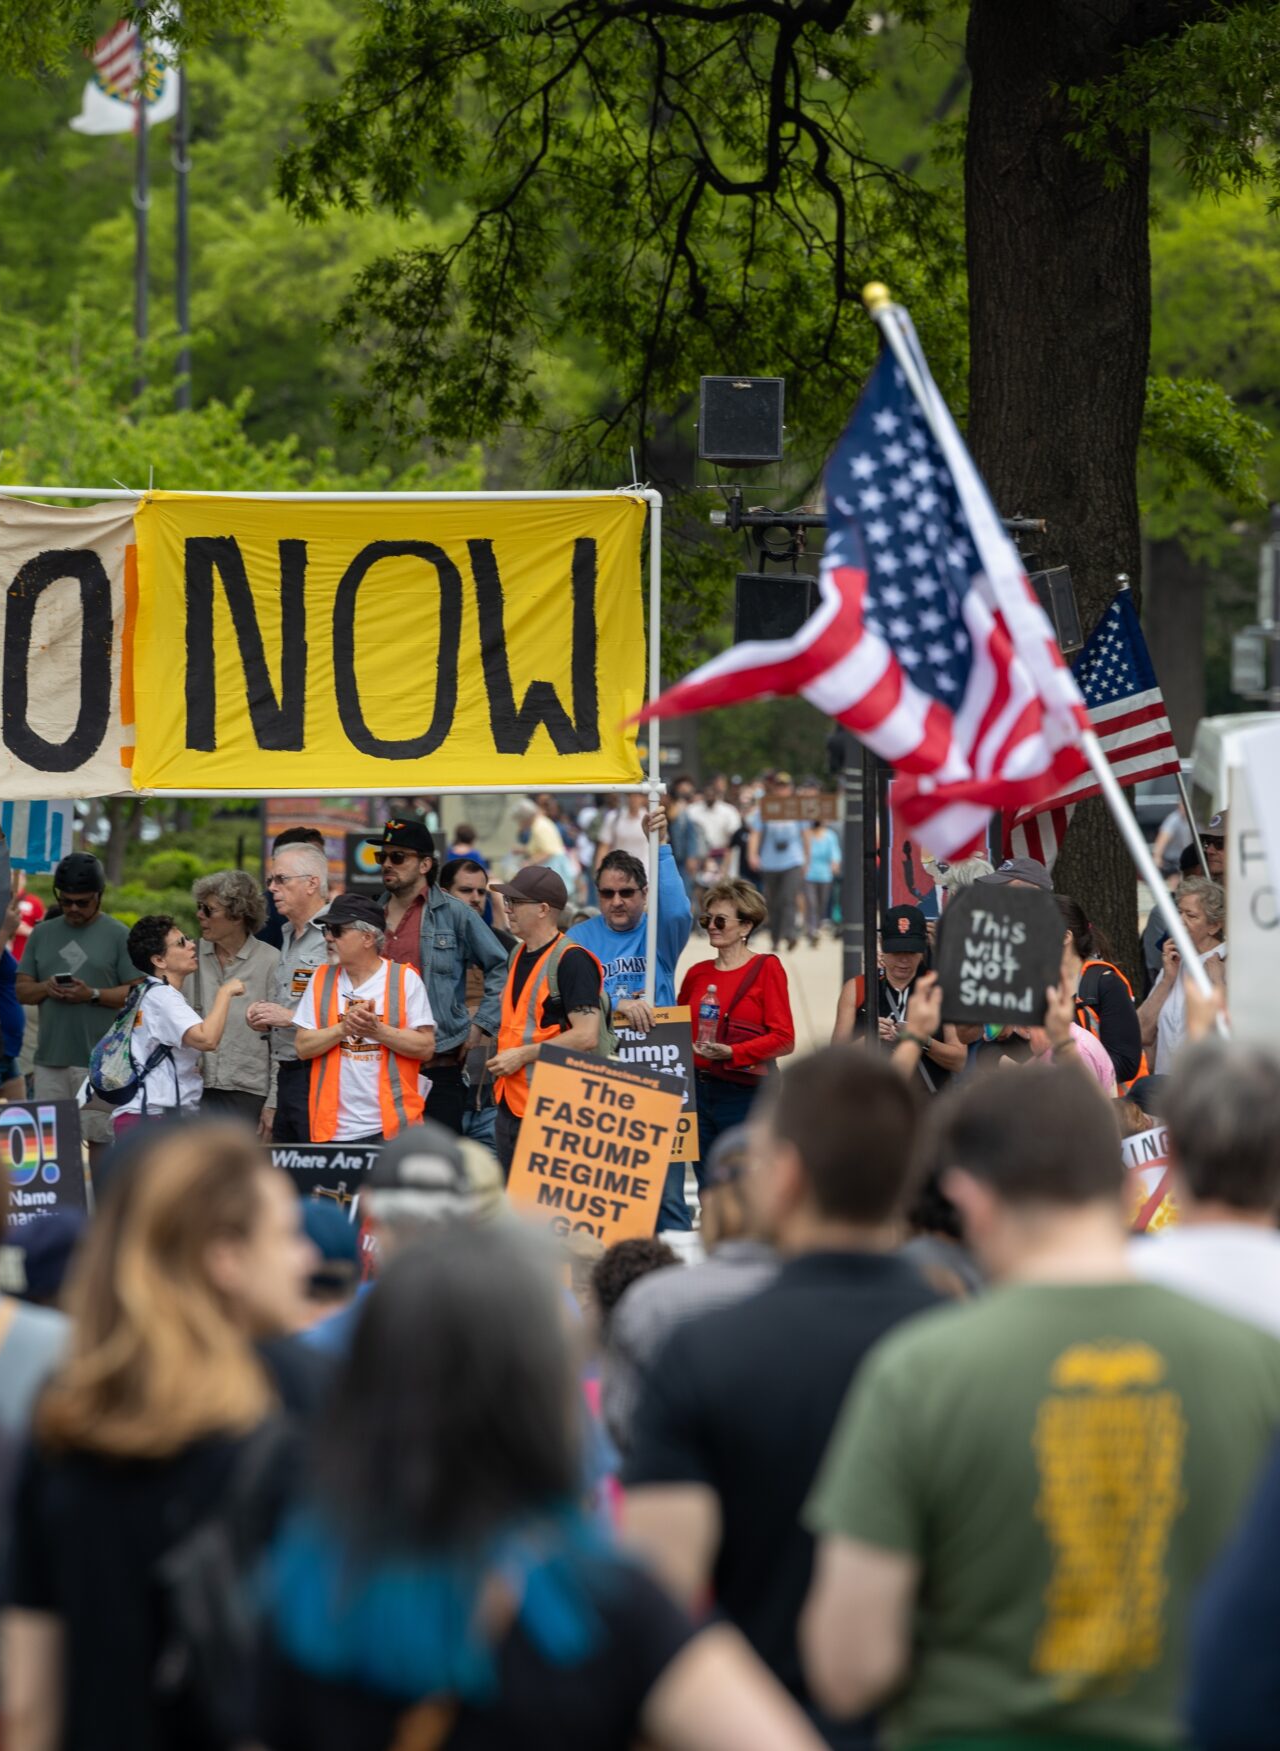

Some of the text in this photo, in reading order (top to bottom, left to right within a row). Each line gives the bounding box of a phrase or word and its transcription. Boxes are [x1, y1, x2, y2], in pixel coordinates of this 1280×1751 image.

[185, 535, 601, 760] NOW
[971, 909, 1026, 944] This
[960, 957, 1019, 983] NOT
[960, 980, 1033, 1013] Stand
[614, 1028, 647, 1041] The
[581, 1078, 636, 1110] The
[534, 1096, 668, 1146] FASCIST
[272, 1150, 328, 1169] Where
[329, 1152, 363, 1169] Are
[541, 1126, 651, 1170] TRUMP
[527, 1152, 651, 1200] REGIME
[8, 1190, 58, 1208] Name
[537, 1183, 629, 1222] MUST
